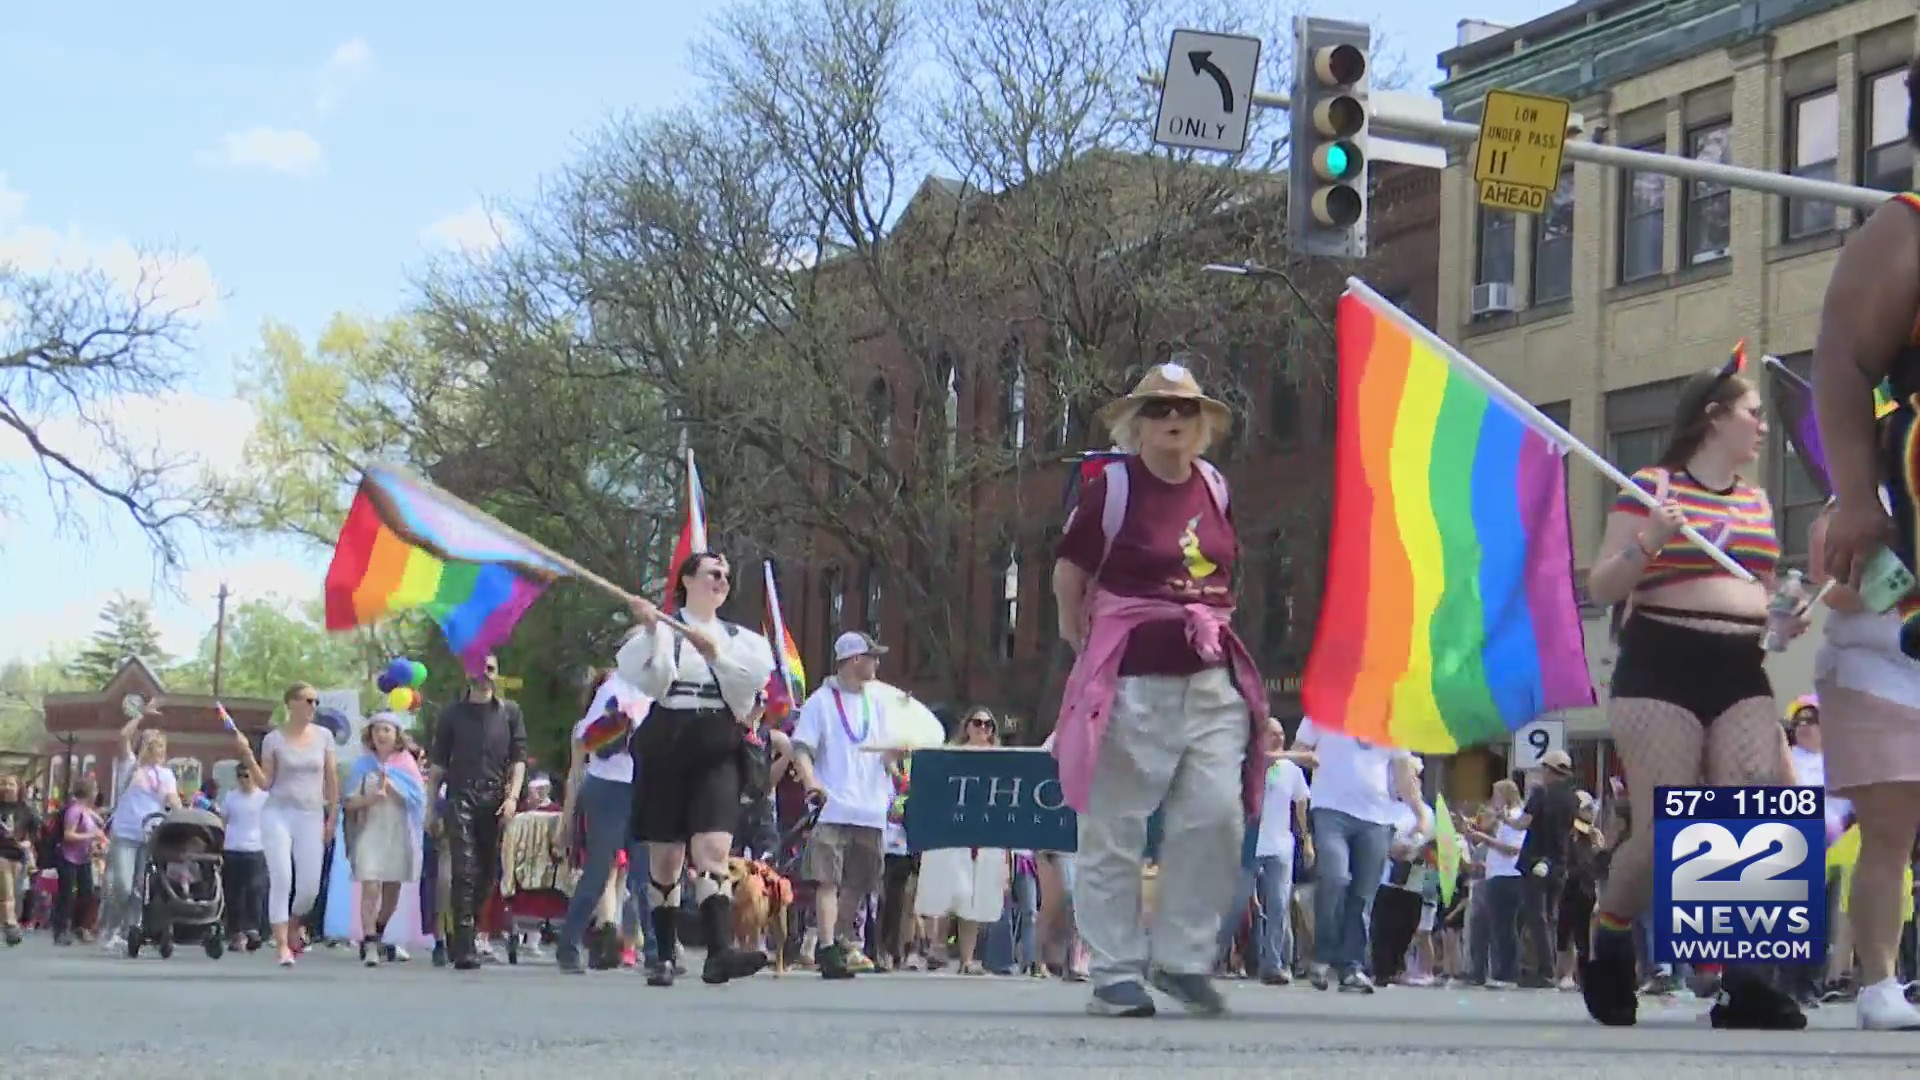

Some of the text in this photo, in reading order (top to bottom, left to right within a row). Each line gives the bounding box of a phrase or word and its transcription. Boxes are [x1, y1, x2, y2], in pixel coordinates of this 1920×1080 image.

[1515, 106, 1538, 122] LOW
[1169, 116, 1226, 140] ONLY
[1488, 126, 1521, 142] UNDER
[1484, 184, 1543, 208] AHEAD
[1528, 729, 1549, 759] 9
